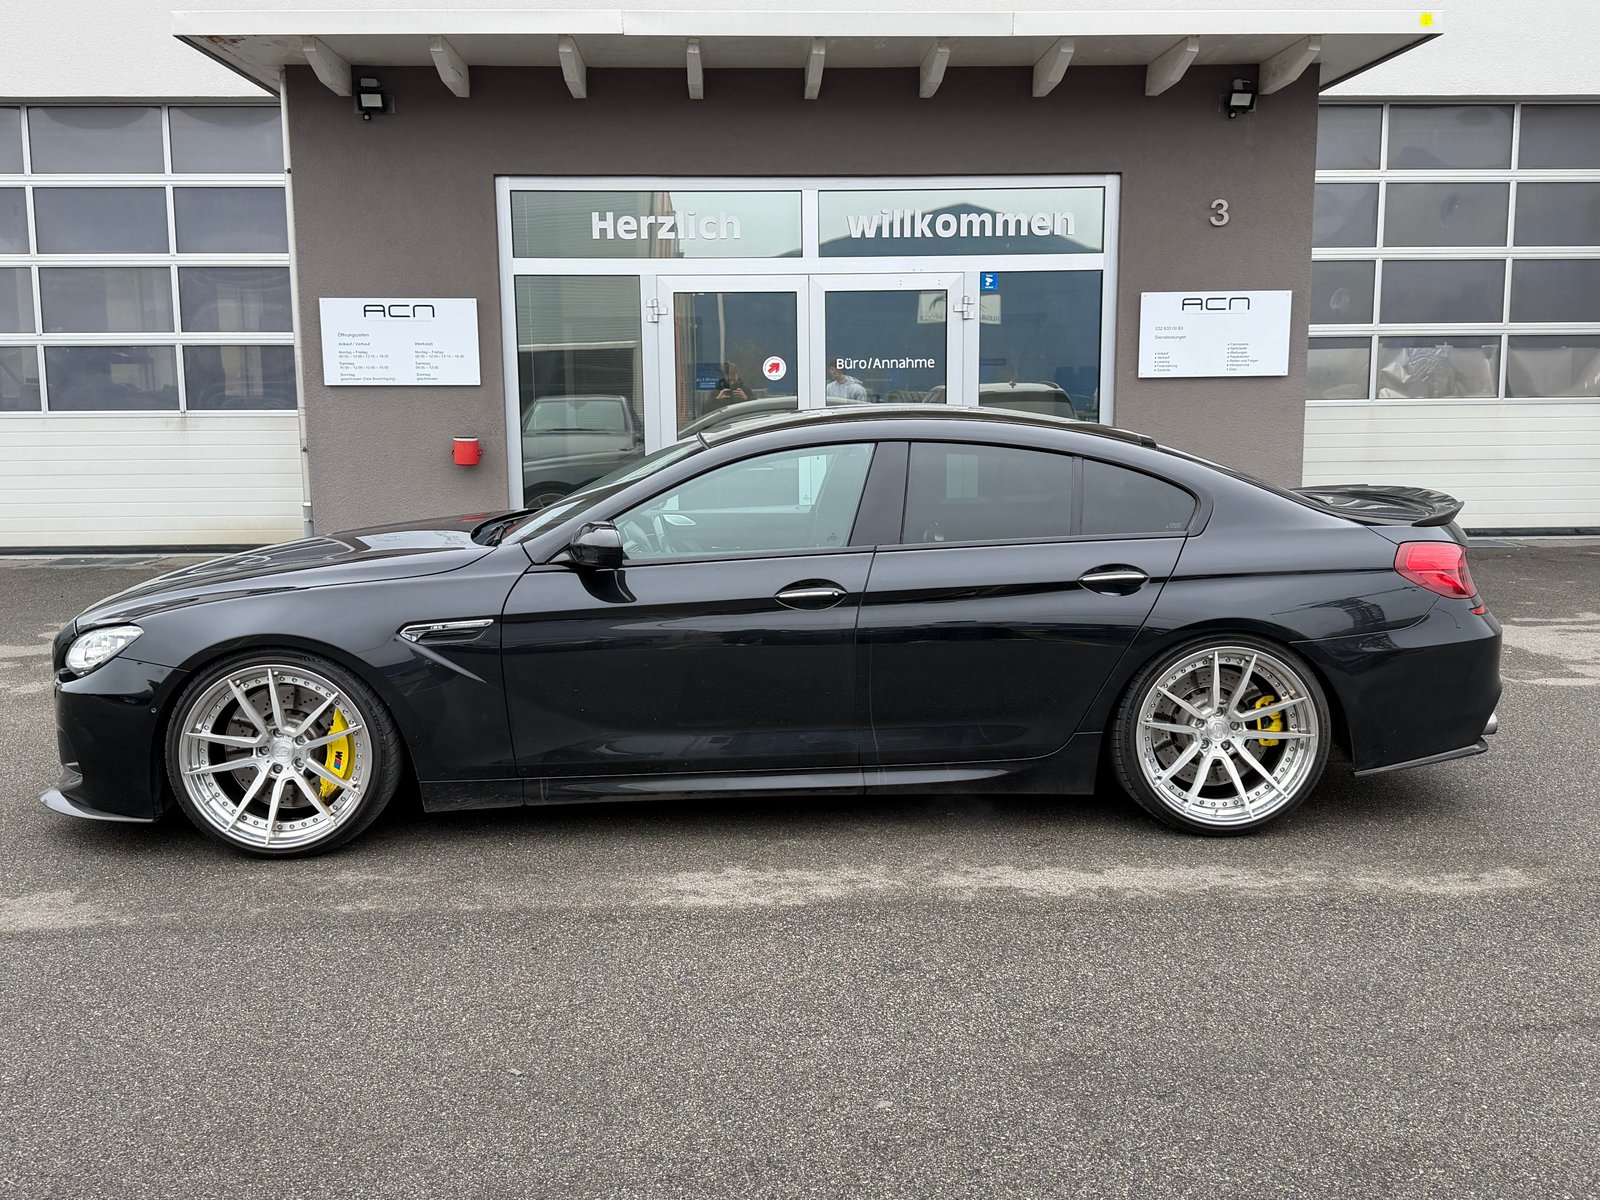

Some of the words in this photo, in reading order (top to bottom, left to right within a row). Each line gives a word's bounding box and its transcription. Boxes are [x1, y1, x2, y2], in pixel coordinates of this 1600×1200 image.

[1209, 198, 1230, 227] 3
[591, 210, 741, 240] Herzlich
[847, 208, 1075, 239] willkommen
[363, 304, 435, 318] ACN
[1182, 297, 1250, 311] ACN
[836, 357, 935, 370] Büro/Annahme
